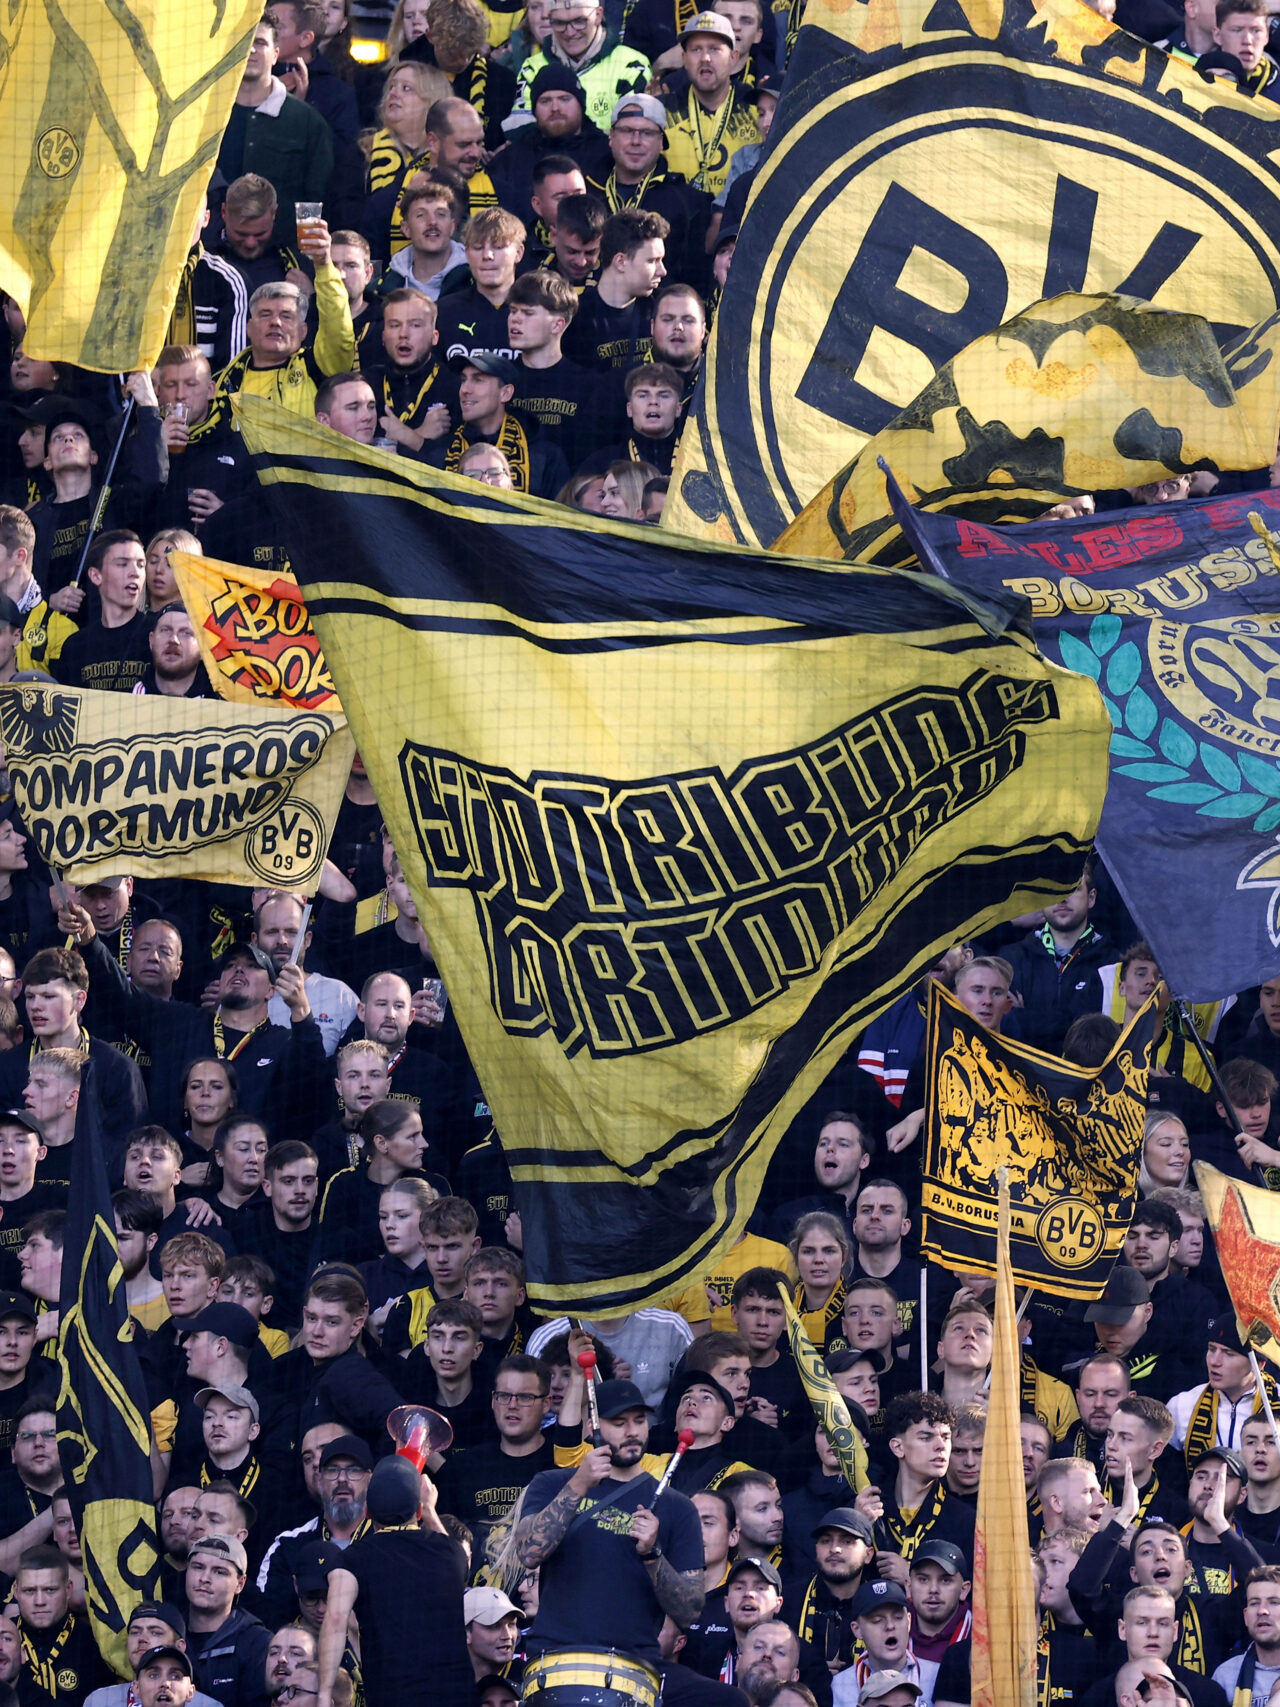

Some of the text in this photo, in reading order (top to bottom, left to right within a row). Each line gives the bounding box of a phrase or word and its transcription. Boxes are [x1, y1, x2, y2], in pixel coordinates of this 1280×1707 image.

[795, 172, 1203, 436] BV
[27, 629, 45, 641] BVB
[212, 579, 316, 645] BO
[215, 645, 338, 700] DOR
[1158, 620, 1187, 688] Boru
[9, 729, 321, 814] COMPANEROS
[399, 669, 1060, 912] SÜDTRIBÜNE
[31, 781, 284, 859] DORTMUND
[261, 810, 315, 858] BVB
[273, 854, 294, 871] 09
[931, 1192, 1025, 1229] B.V.BORUSIA
[1046, 1206, 1098, 1249] BVB
[1059, 1245, 1077, 1259] 09
[59, 1670, 76, 1683] BVB
